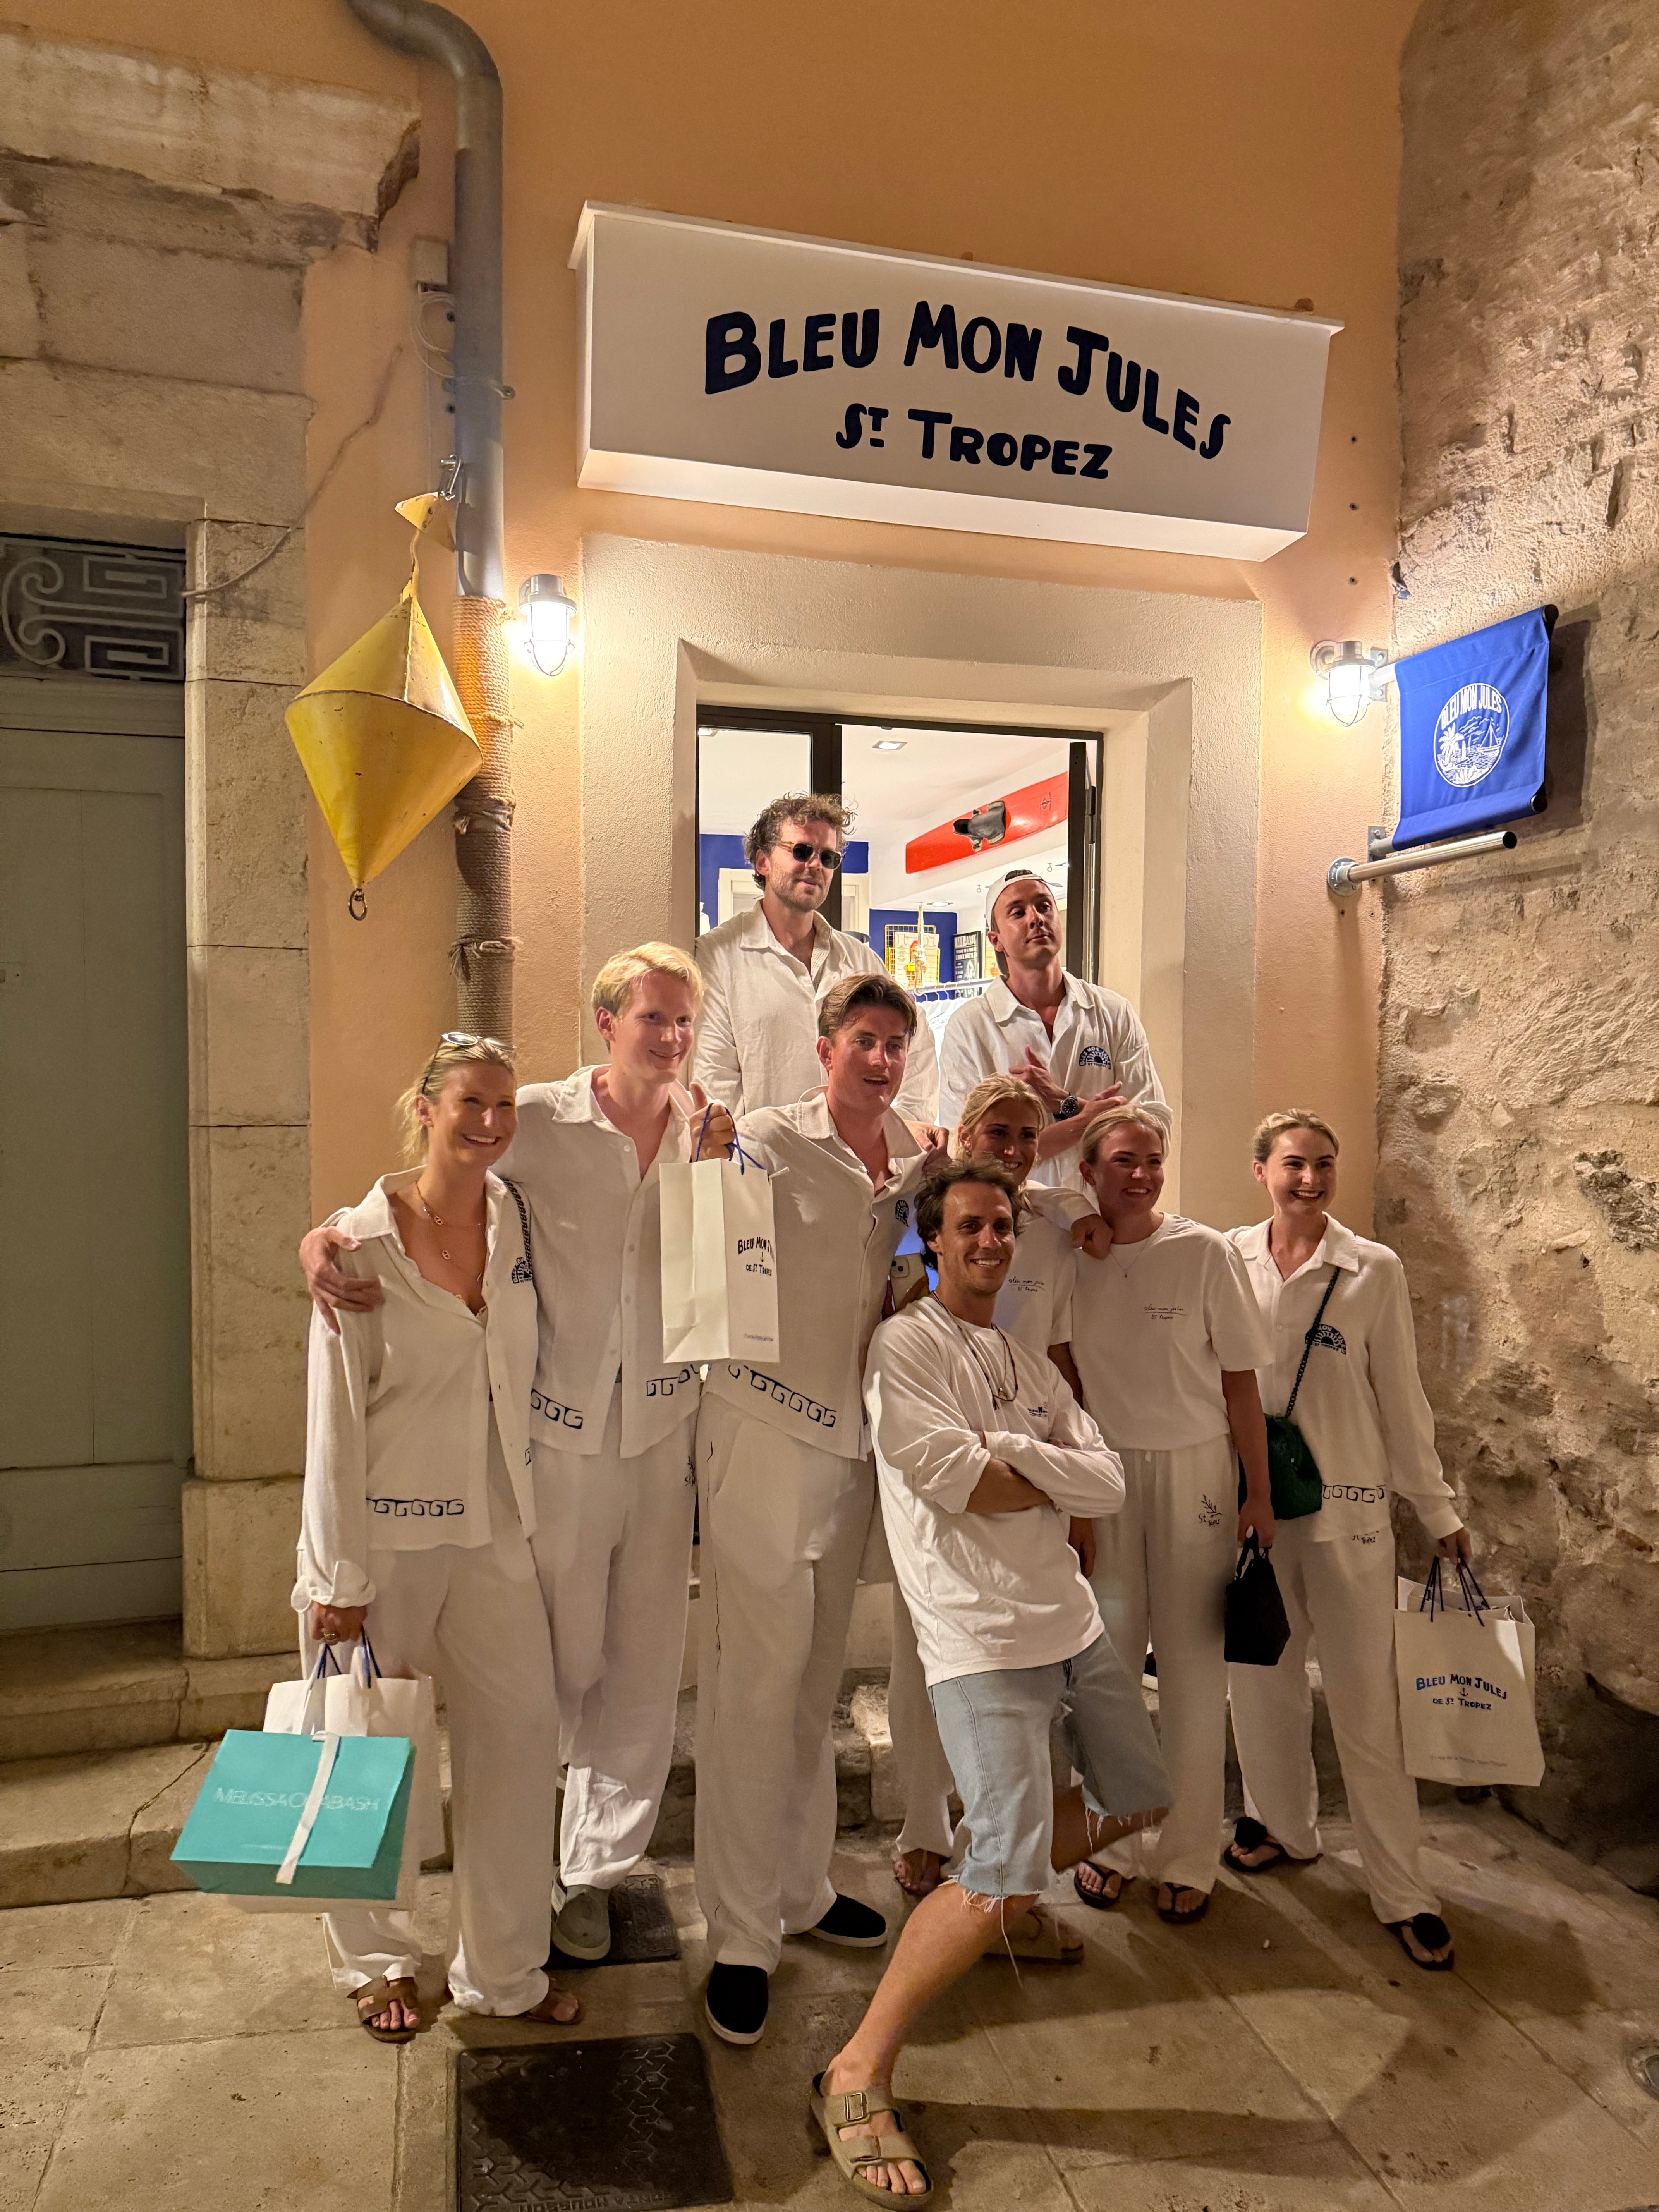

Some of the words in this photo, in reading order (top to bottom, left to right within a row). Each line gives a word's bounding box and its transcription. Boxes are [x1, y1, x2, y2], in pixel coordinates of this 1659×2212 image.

[704, 308, 880, 395] BLEU
[903, 300, 1042, 382] MON
[1057, 326, 1231, 459] JULES
[907, 408, 1113, 479] TROPEZ
[1440, 693, 1460, 730] BLEU
[1460, 684, 1477, 715] MON
[1478, 685, 1502, 713] JULES
[738, 1238, 754, 1255] BLEU
[756, 1236, 767, 1250] MON
[1415, 1676, 1445, 1691] BLEU
[1449, 1673, 1472, 1687] MON
[1474, 1677, 1507, 1700] JULES
[1458, 1697, 1492, 1711] TROPEZ
